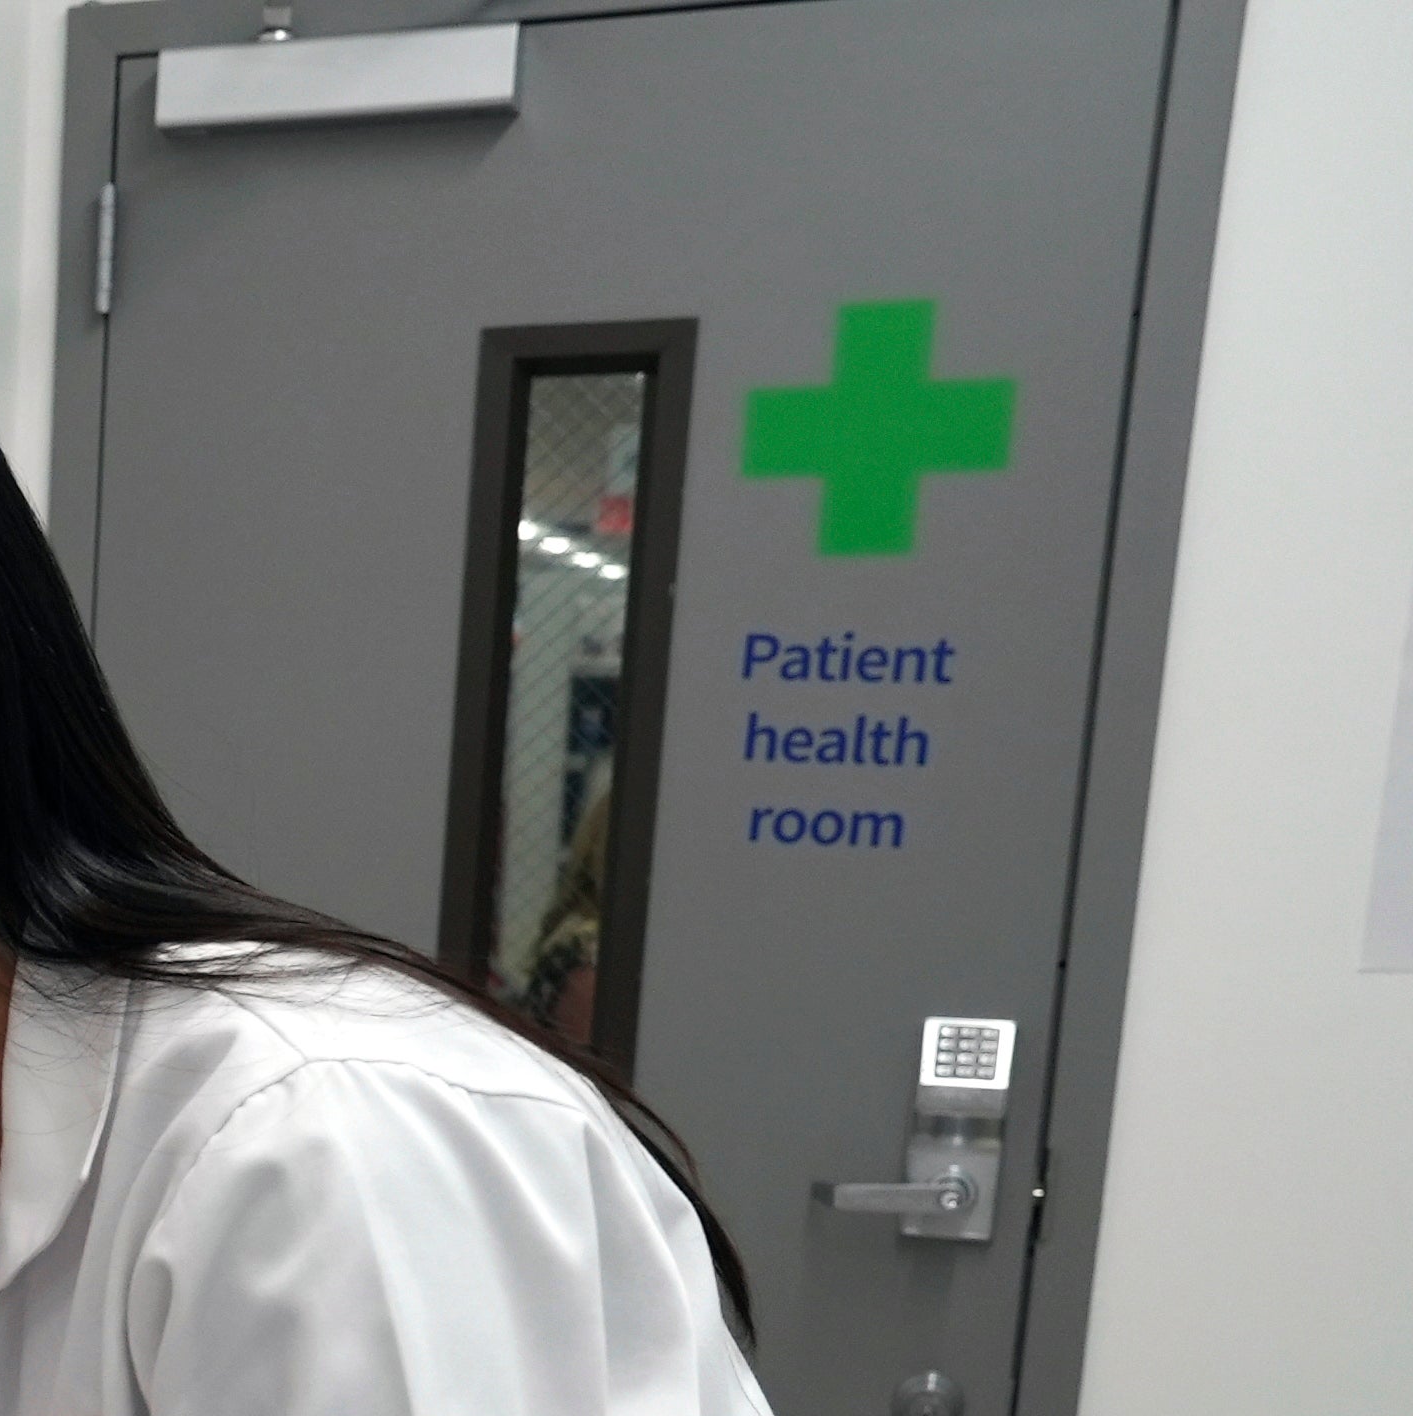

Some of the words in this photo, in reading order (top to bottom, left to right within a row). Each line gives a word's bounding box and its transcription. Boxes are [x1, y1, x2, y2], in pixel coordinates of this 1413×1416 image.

[741, 630, 956, 685] Patient
[743, 712, 930, 767] health
[747, 807, 905, 848] room
